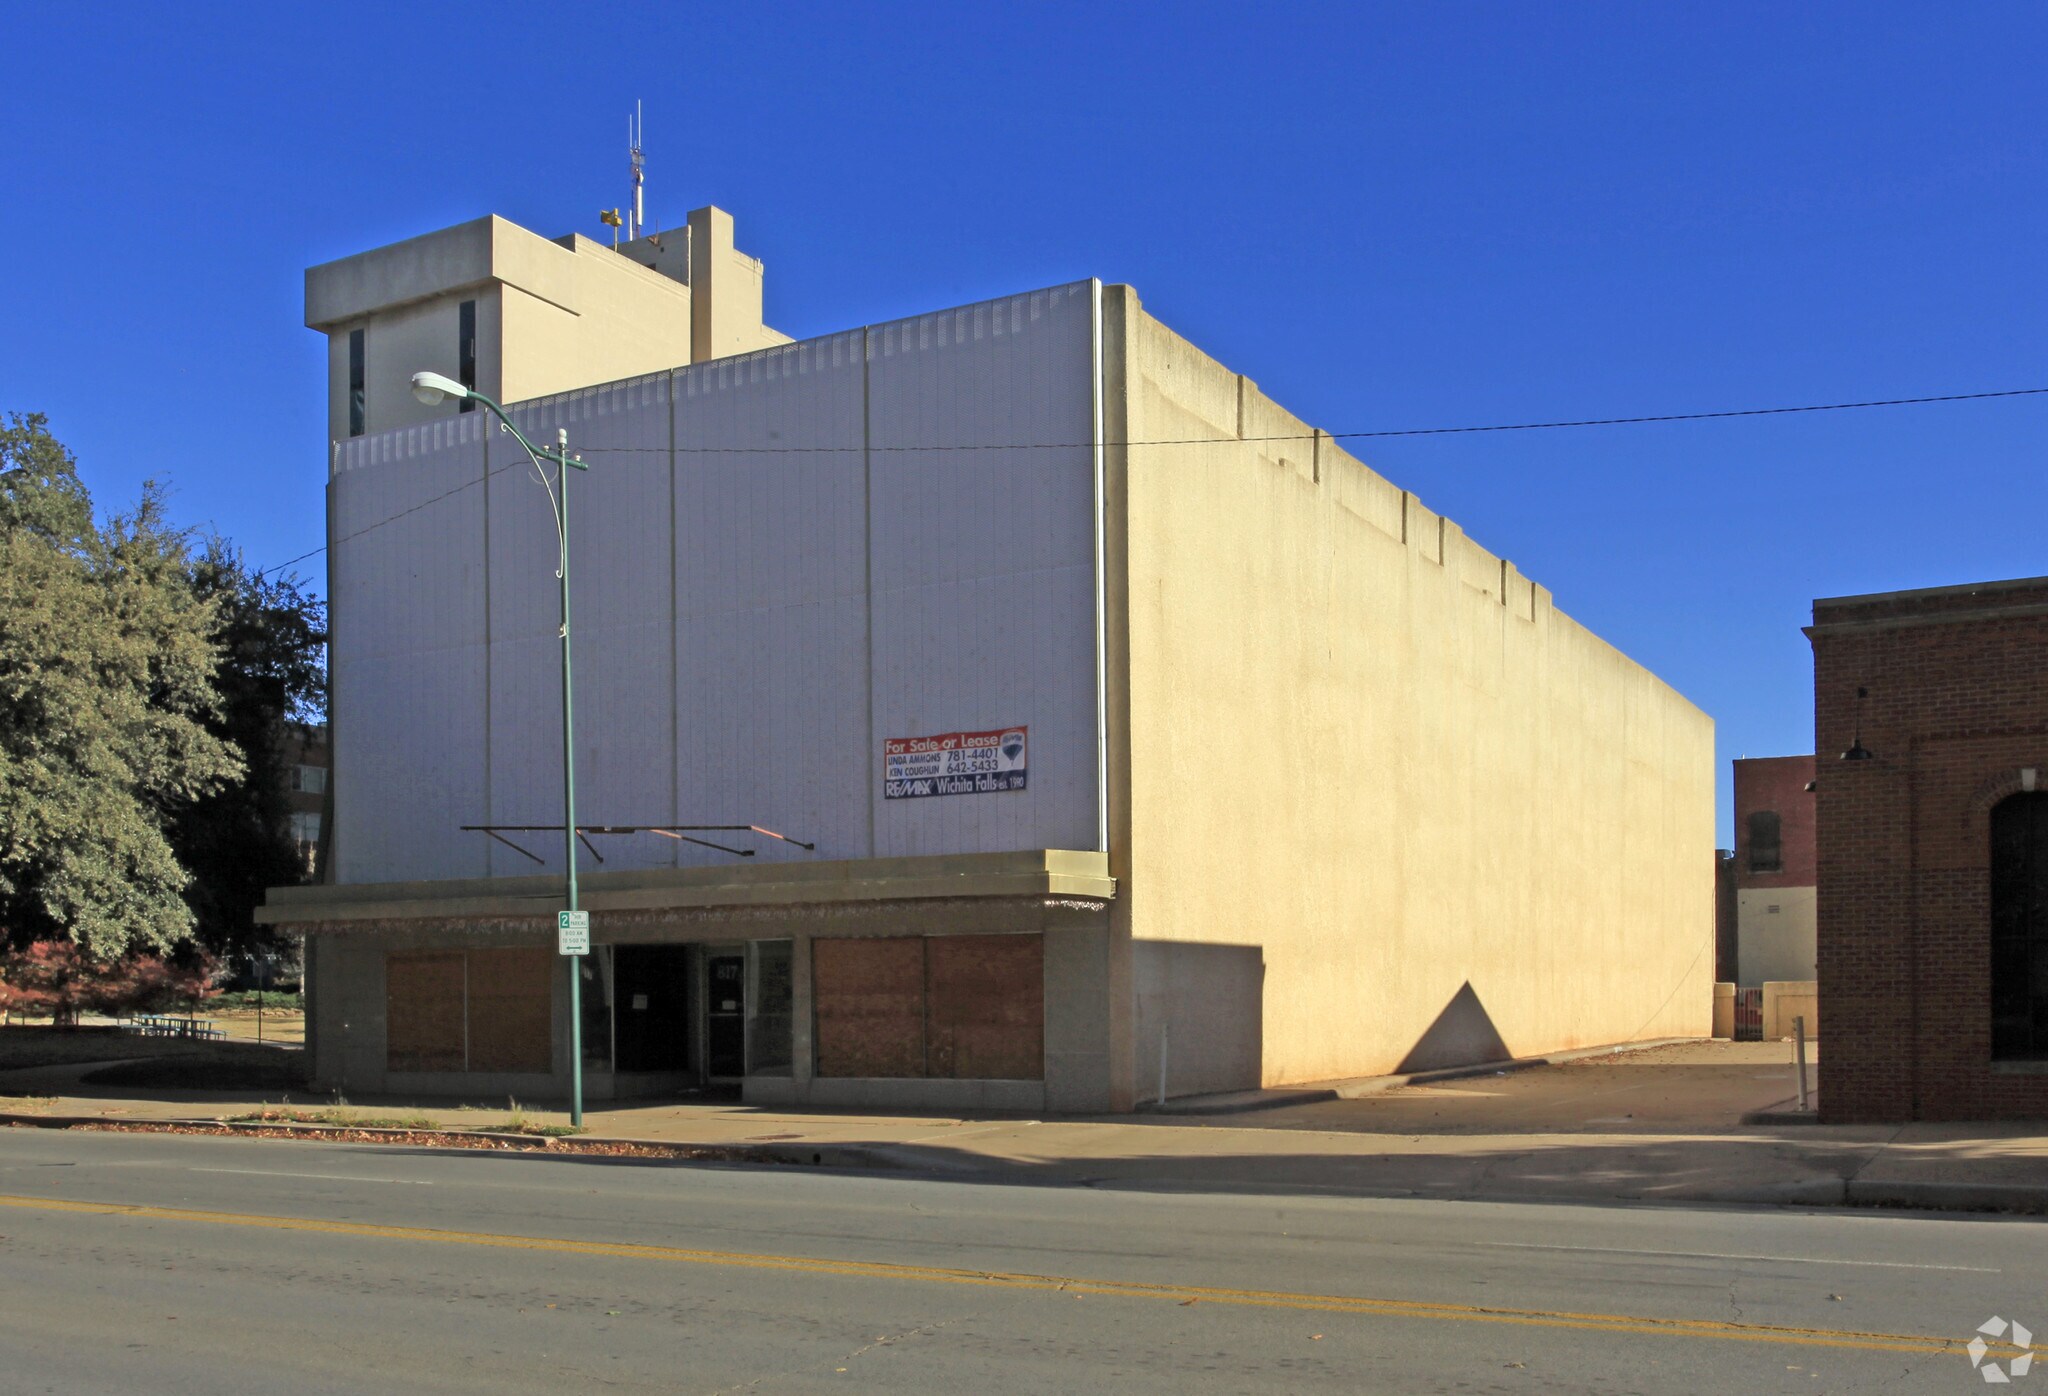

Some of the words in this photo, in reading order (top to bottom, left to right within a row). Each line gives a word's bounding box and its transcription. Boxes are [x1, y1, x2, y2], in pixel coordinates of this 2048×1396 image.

[886, 740, 906, 754] For
[910, 738, 939, 752] Sale
[941, 738, 958, 749] or
[961, 734, 999, 747] Lease
[888, 754, 907, 766] LINDA
[908, 752, 941, 765] AMMONS
[947, 748, 998, 762] 781-4401
[889, 767, 903, 778] KEN
[904, 765, 940, 777] COUGHLIN
[947, 760, 998, 774] 642-5433
[886, 779, 931, 797] RE/MAX
[936, 775, 973, 794] Wichita
[975, 773, 997, 791] Falls
[561, 915, 568, 926] 2
